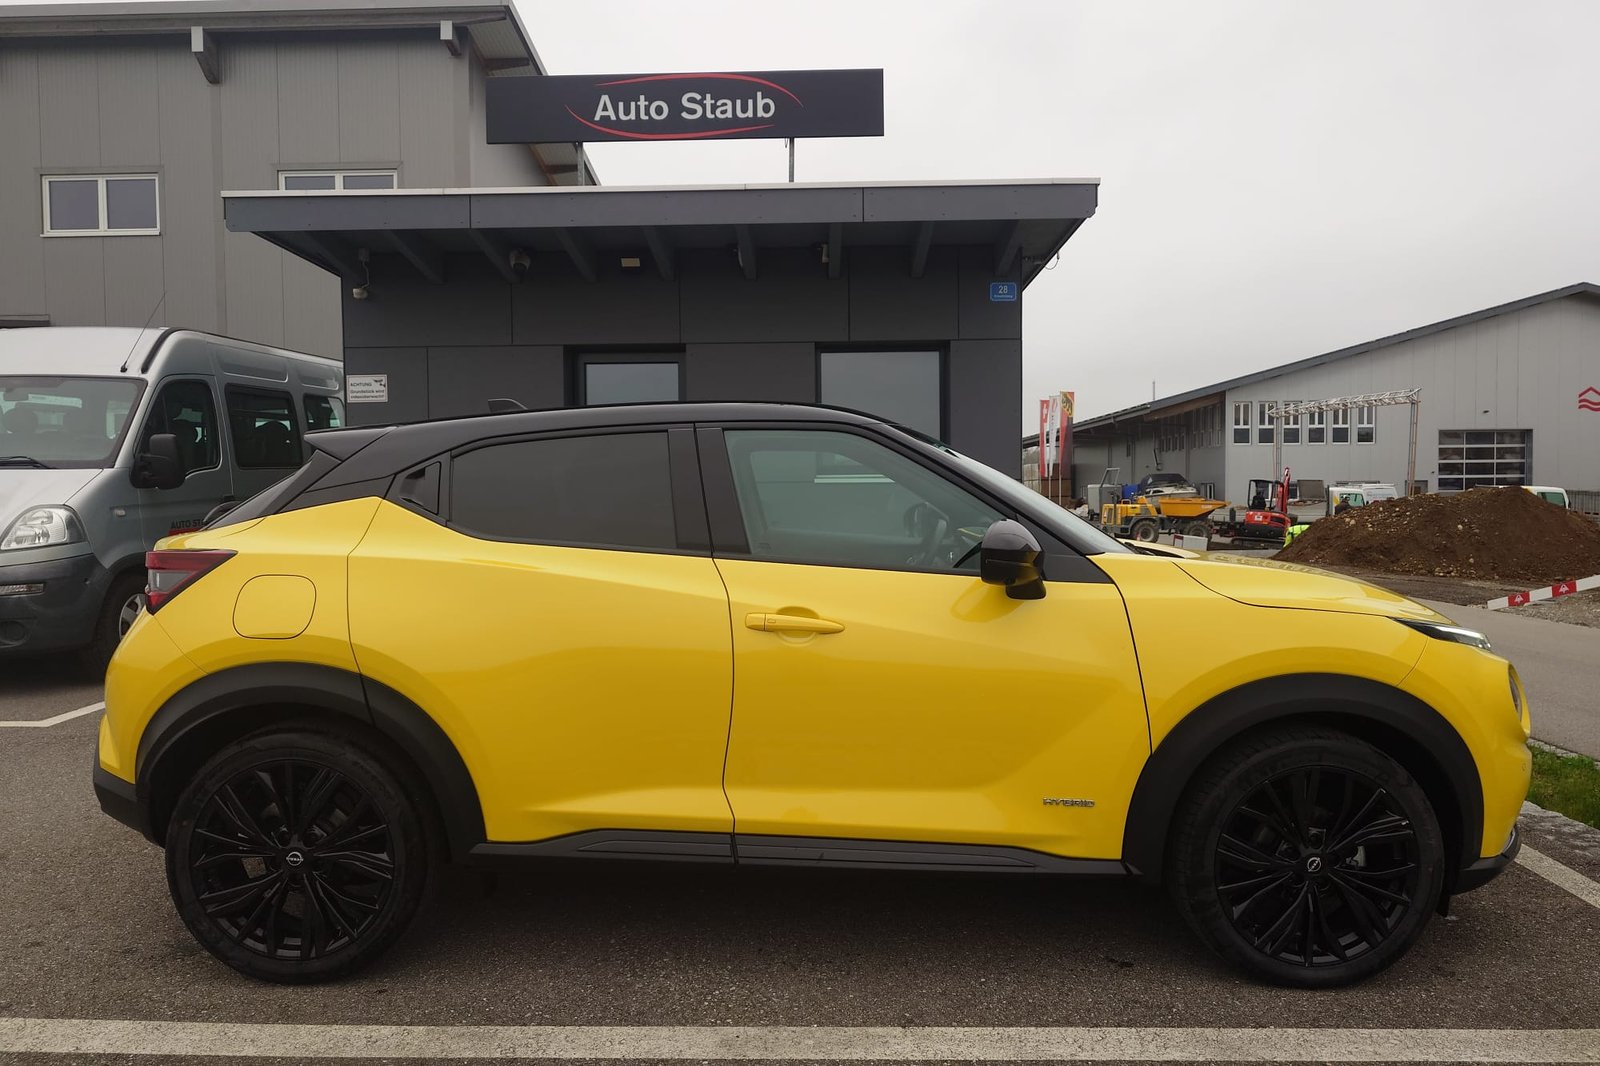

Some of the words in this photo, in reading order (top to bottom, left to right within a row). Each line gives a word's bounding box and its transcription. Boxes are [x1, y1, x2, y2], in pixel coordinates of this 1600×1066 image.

[594, 94, 669, 121] Auto
[681, 91, 776, 120] Staub
[998, 285, 1008, 294] 28
[170, 519, 192, 529] AUTO
[1043, 797, 1095, 808] HYBRID
